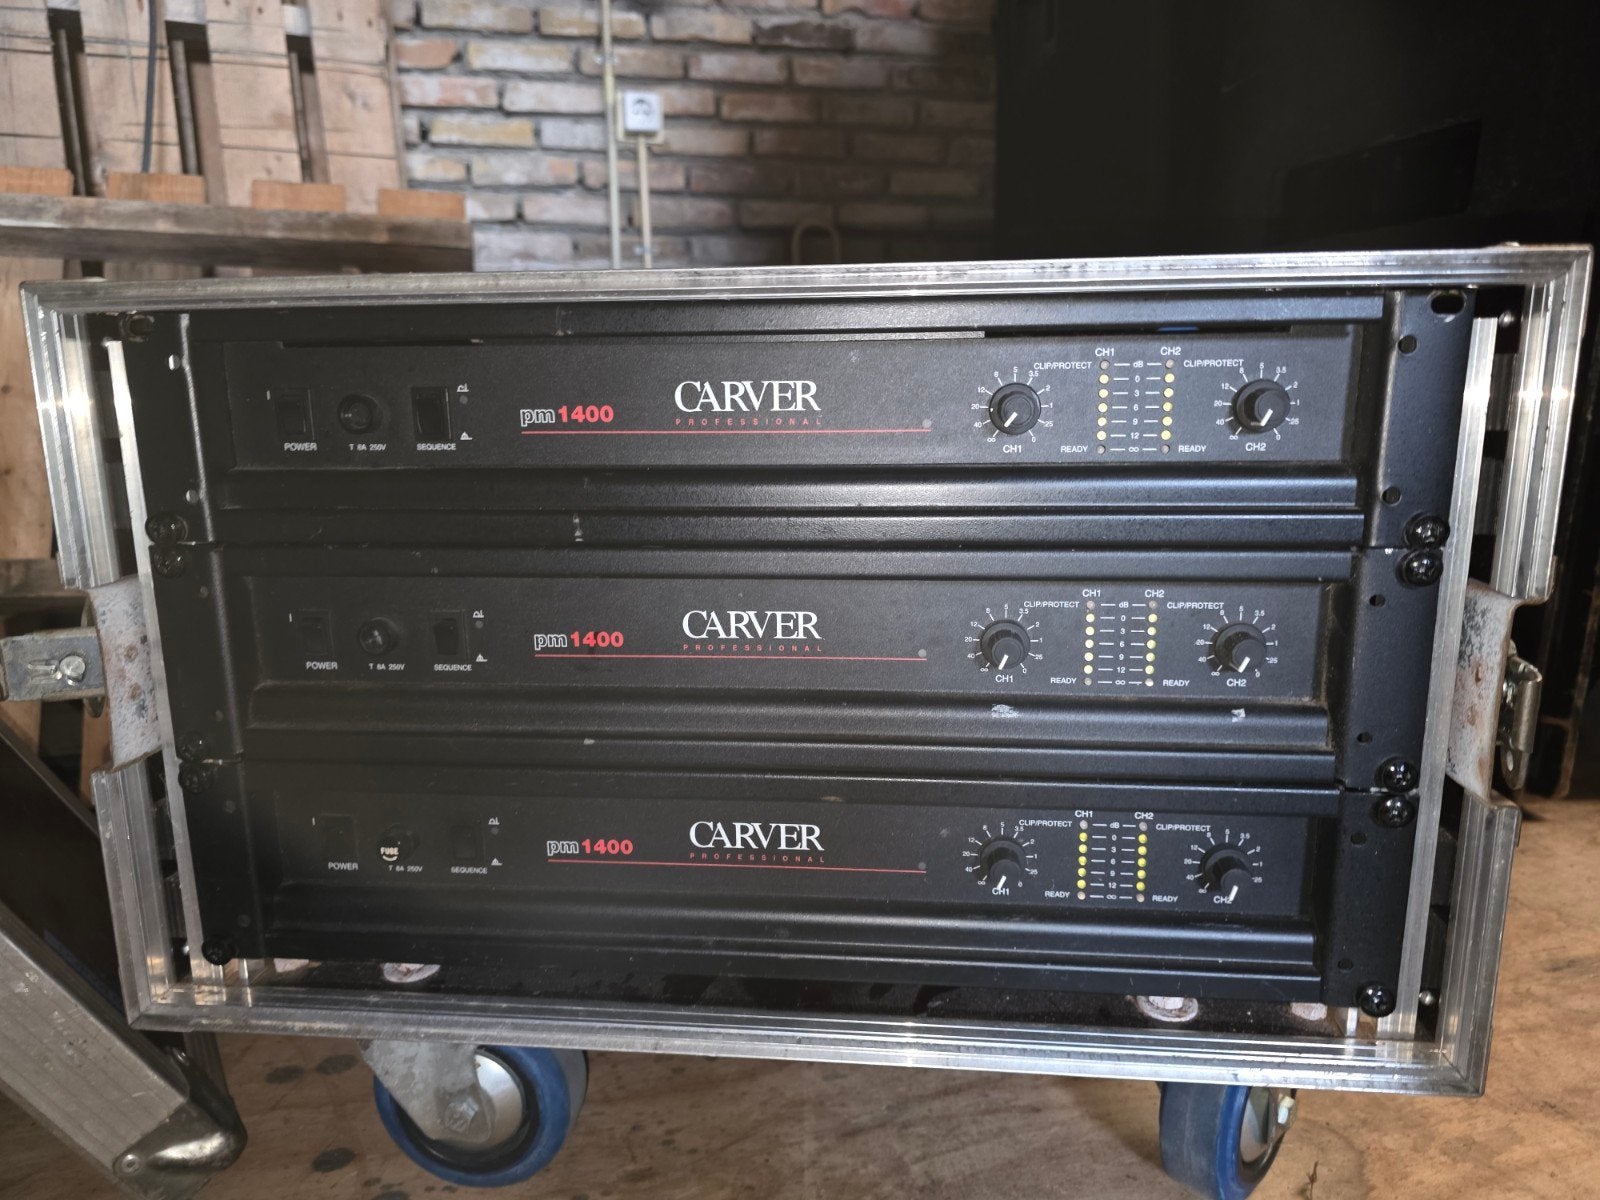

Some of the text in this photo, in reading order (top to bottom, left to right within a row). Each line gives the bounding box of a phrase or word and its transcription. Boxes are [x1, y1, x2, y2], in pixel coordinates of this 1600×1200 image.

[1094, 347, 1115, 357] CH1
[1160, 346, 1182, 356] CH2
[1033, 361, 1092, 370] CLIP/PROTECT
[1132, 360, 1144, 368] dB
[1183, 359, 1244, 368] CLIP/PROTECT
[1134, 375, 1141, 383] 0
[674, 380, 821, 412] CARVER
[1134, 389, 1140, 397] 3
[675, 417, 821, 426] PROFESSIONAL
[1132, 417, 1139, 426] 9
[1130, 432, 1140, 440] 12
[284, 442, 317, 451] POWER
[416, 442, 456, 451] SEQUENCE
[1002, 444, 1022, 453] CH1
[1060, 445, 1088, 453] READY
[1178, 444, 1207, 453] READY
[1245, 442, 1267, 452] CH2
[1082, 588, 1101, 598] CH1
[1144, 589, 1165, 598] CH2
[1166, 601, 1224, 610] CLIP/PROTECT
[682, 610, 822, 640] CARVER
[683, 644, 822, 652] PROFESSIONAL
[306, 661, 338, 670] POWER
[433, 663, 472, 672] SEQUENCE
[1116, 666, 1126, 674] 12
[995, 674, 1014, 683] CH1
[1162, 679, 1190, 687] READY
[1226, 678, 1247, 687] CH2
[1074, 810, 1093, 818] CH1
[1134, 811, 1155, 820] CH2
[1018, 819, 1073, 828] CLIP/PROTECT
[1109, 821, 1120, 829] dB
[1155, 823, 1211, 832] CLIP/PROTECT
[689, 821, 825, 850] CARVER
[380, 846, 399, 855] FUSE
[690, 852, 825, 863] PROFESSIONAL
[328, 861, 358, 871] POWER
[451, 866, 488, 875] SEQUENCE
[991, 887, 1010, 896] CH1
[1044, 890, 1071, 898] READY
[1152, 894, 1179, 902] READY
